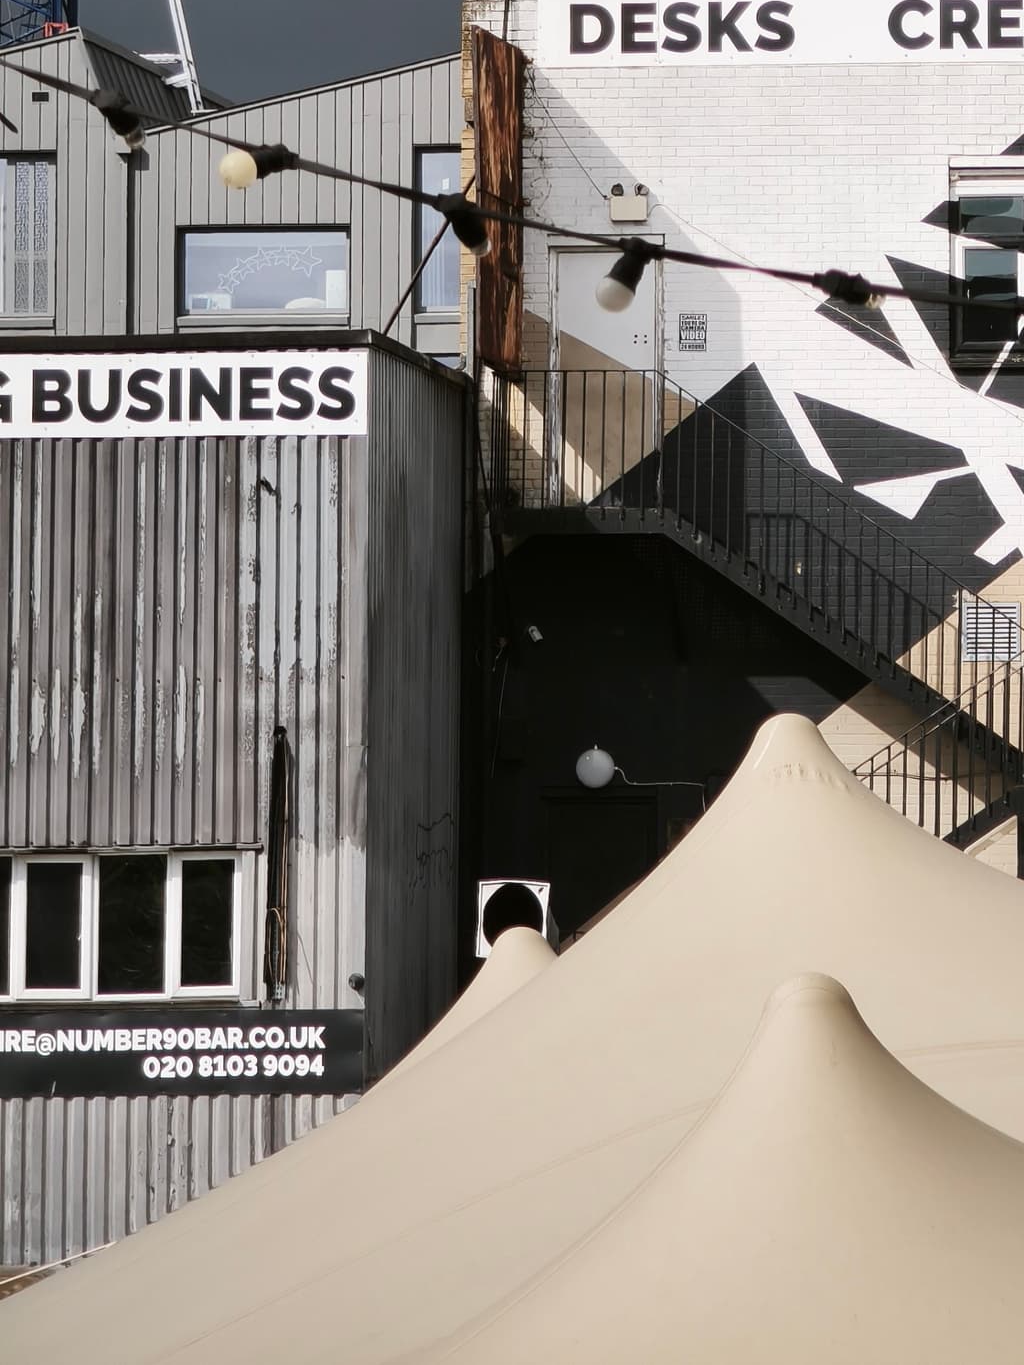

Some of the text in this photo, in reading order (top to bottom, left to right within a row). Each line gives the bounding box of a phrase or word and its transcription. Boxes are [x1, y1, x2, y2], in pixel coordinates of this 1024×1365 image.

[569, 0, 796, 55] DESKS
[681, 331, 705, 339] VIDEO
[32, 366, 356, 423] BUSINESS
[143, 1054, 325, 1078] 020 8103 9094
